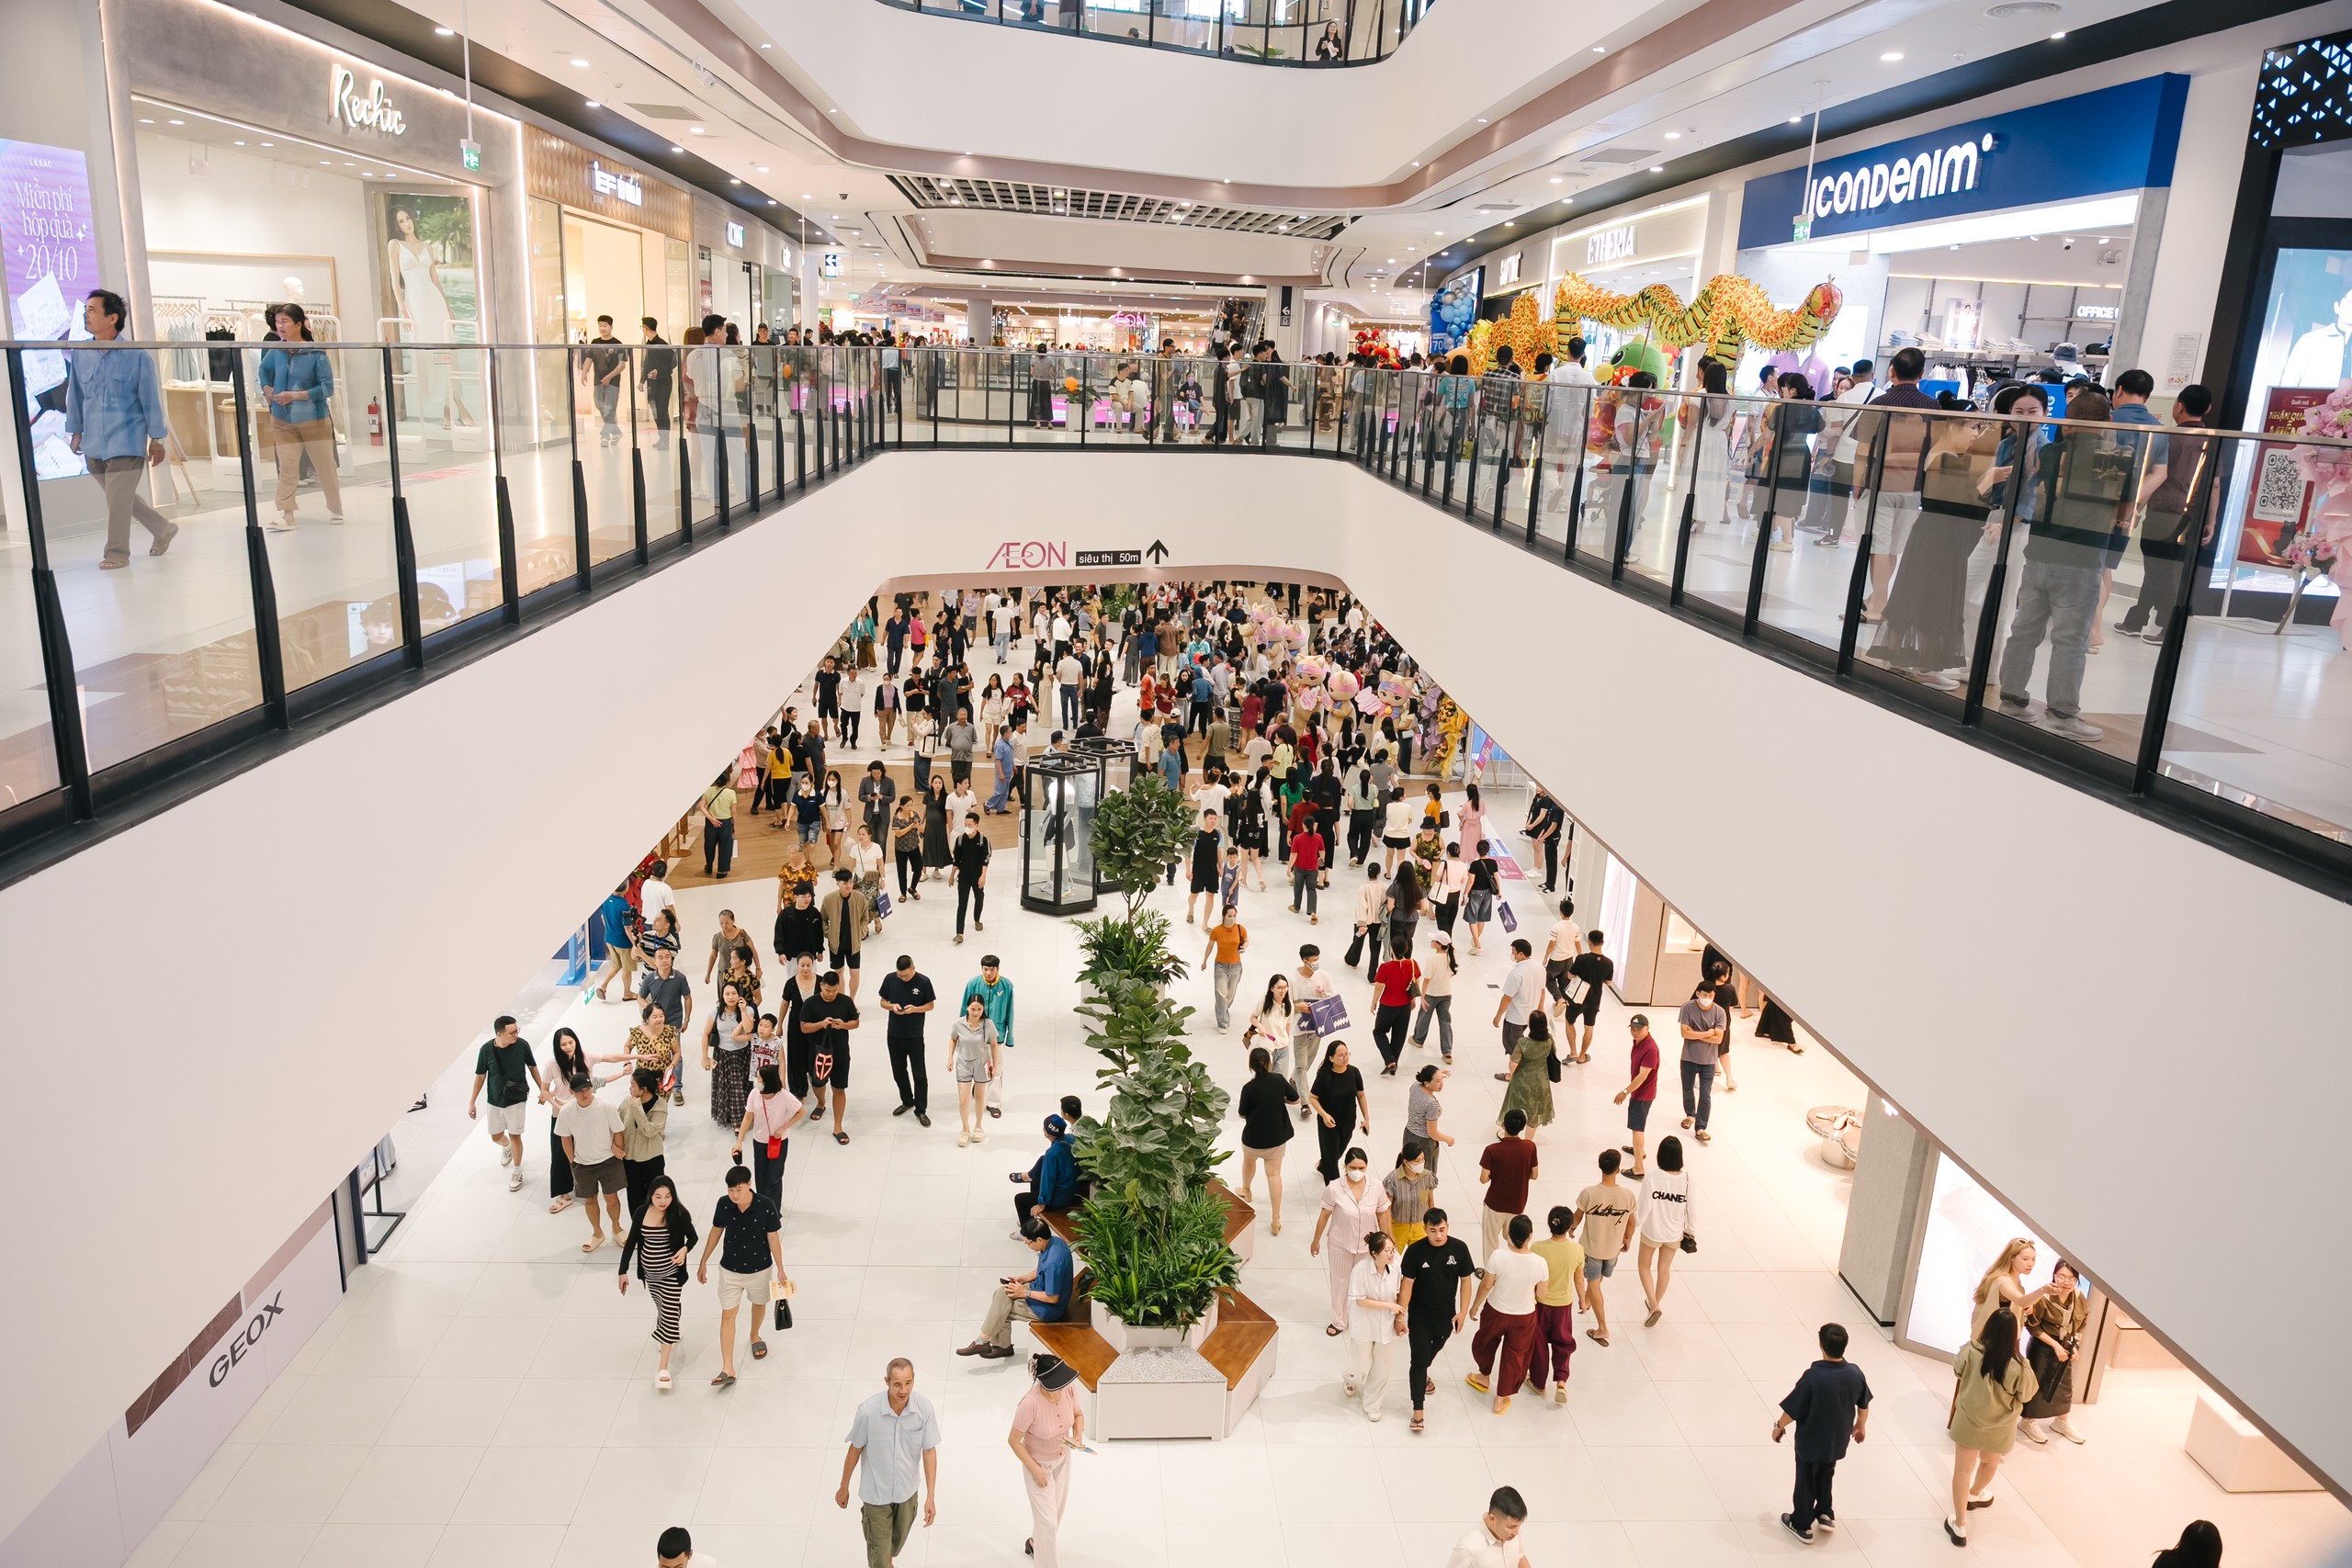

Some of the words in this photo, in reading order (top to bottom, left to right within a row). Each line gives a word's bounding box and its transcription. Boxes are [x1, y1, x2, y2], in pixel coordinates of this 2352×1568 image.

[332, 63, 407, 135] Rechic
[15, 176, 51, 210] Miễn
[52, 186, 74, 217] phí
[22, 209, 48, 244] hộp
[50, 212, 74, 244] quà
[25, 243, 78, 281] 20/10
[2076, 305, 2114, 319] OFFICE
[1079, 554, 1099, 564] siêu
[1102, 554, 1114, 565] thị
[1119, 554, 1139, 563] 50m
[209, 1289, 285, 1388] GEOX
